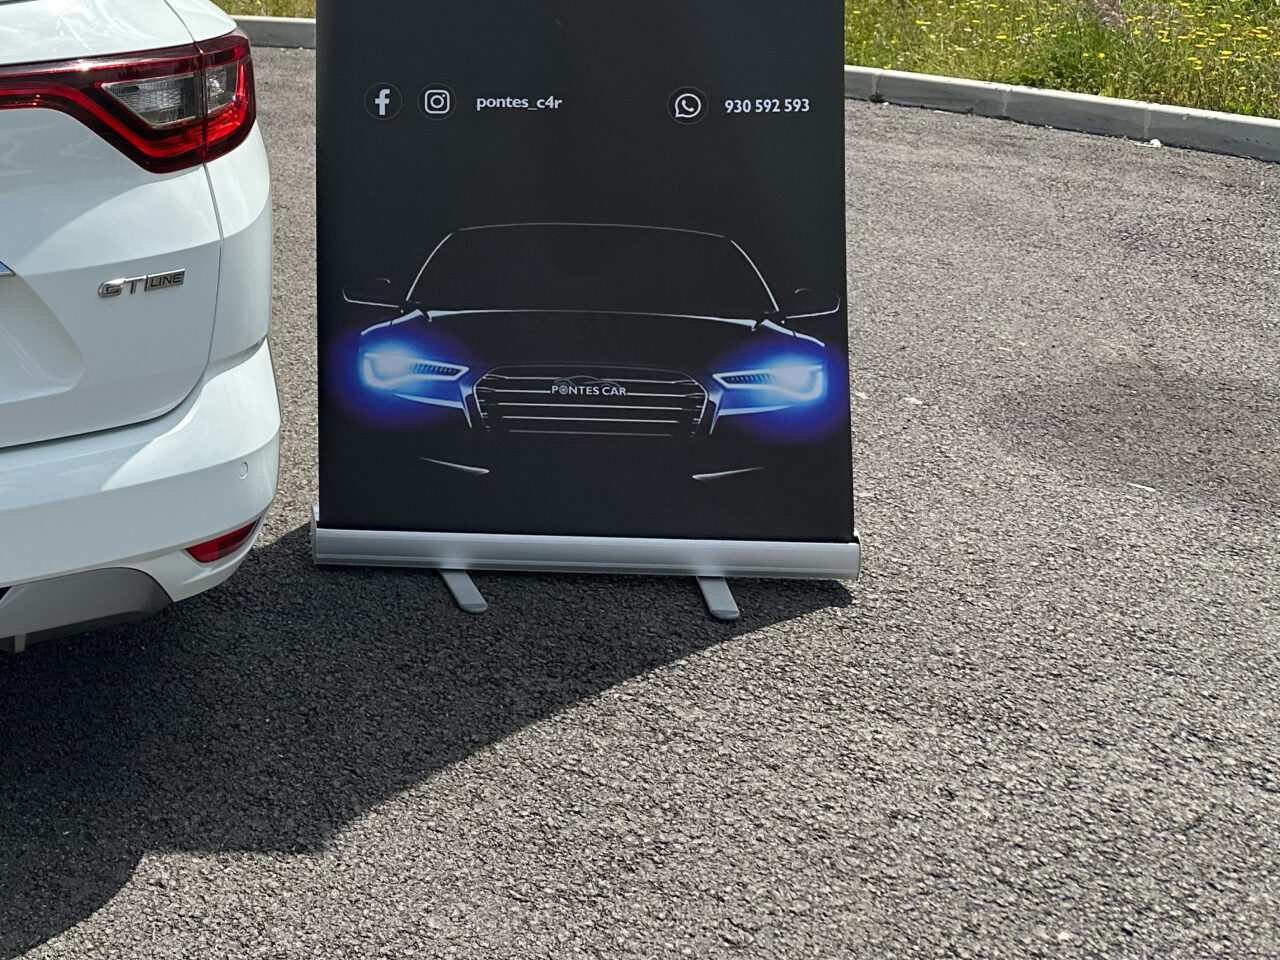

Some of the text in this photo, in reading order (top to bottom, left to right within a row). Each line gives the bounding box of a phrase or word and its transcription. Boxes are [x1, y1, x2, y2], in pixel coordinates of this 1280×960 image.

[476, 95, 563, 112] pontes_c4r
[724, 98, 810, 113] 930 592 593
[150, 273, 182, 288] LINE
[551, 384, 627, 397] PONTES CAR
